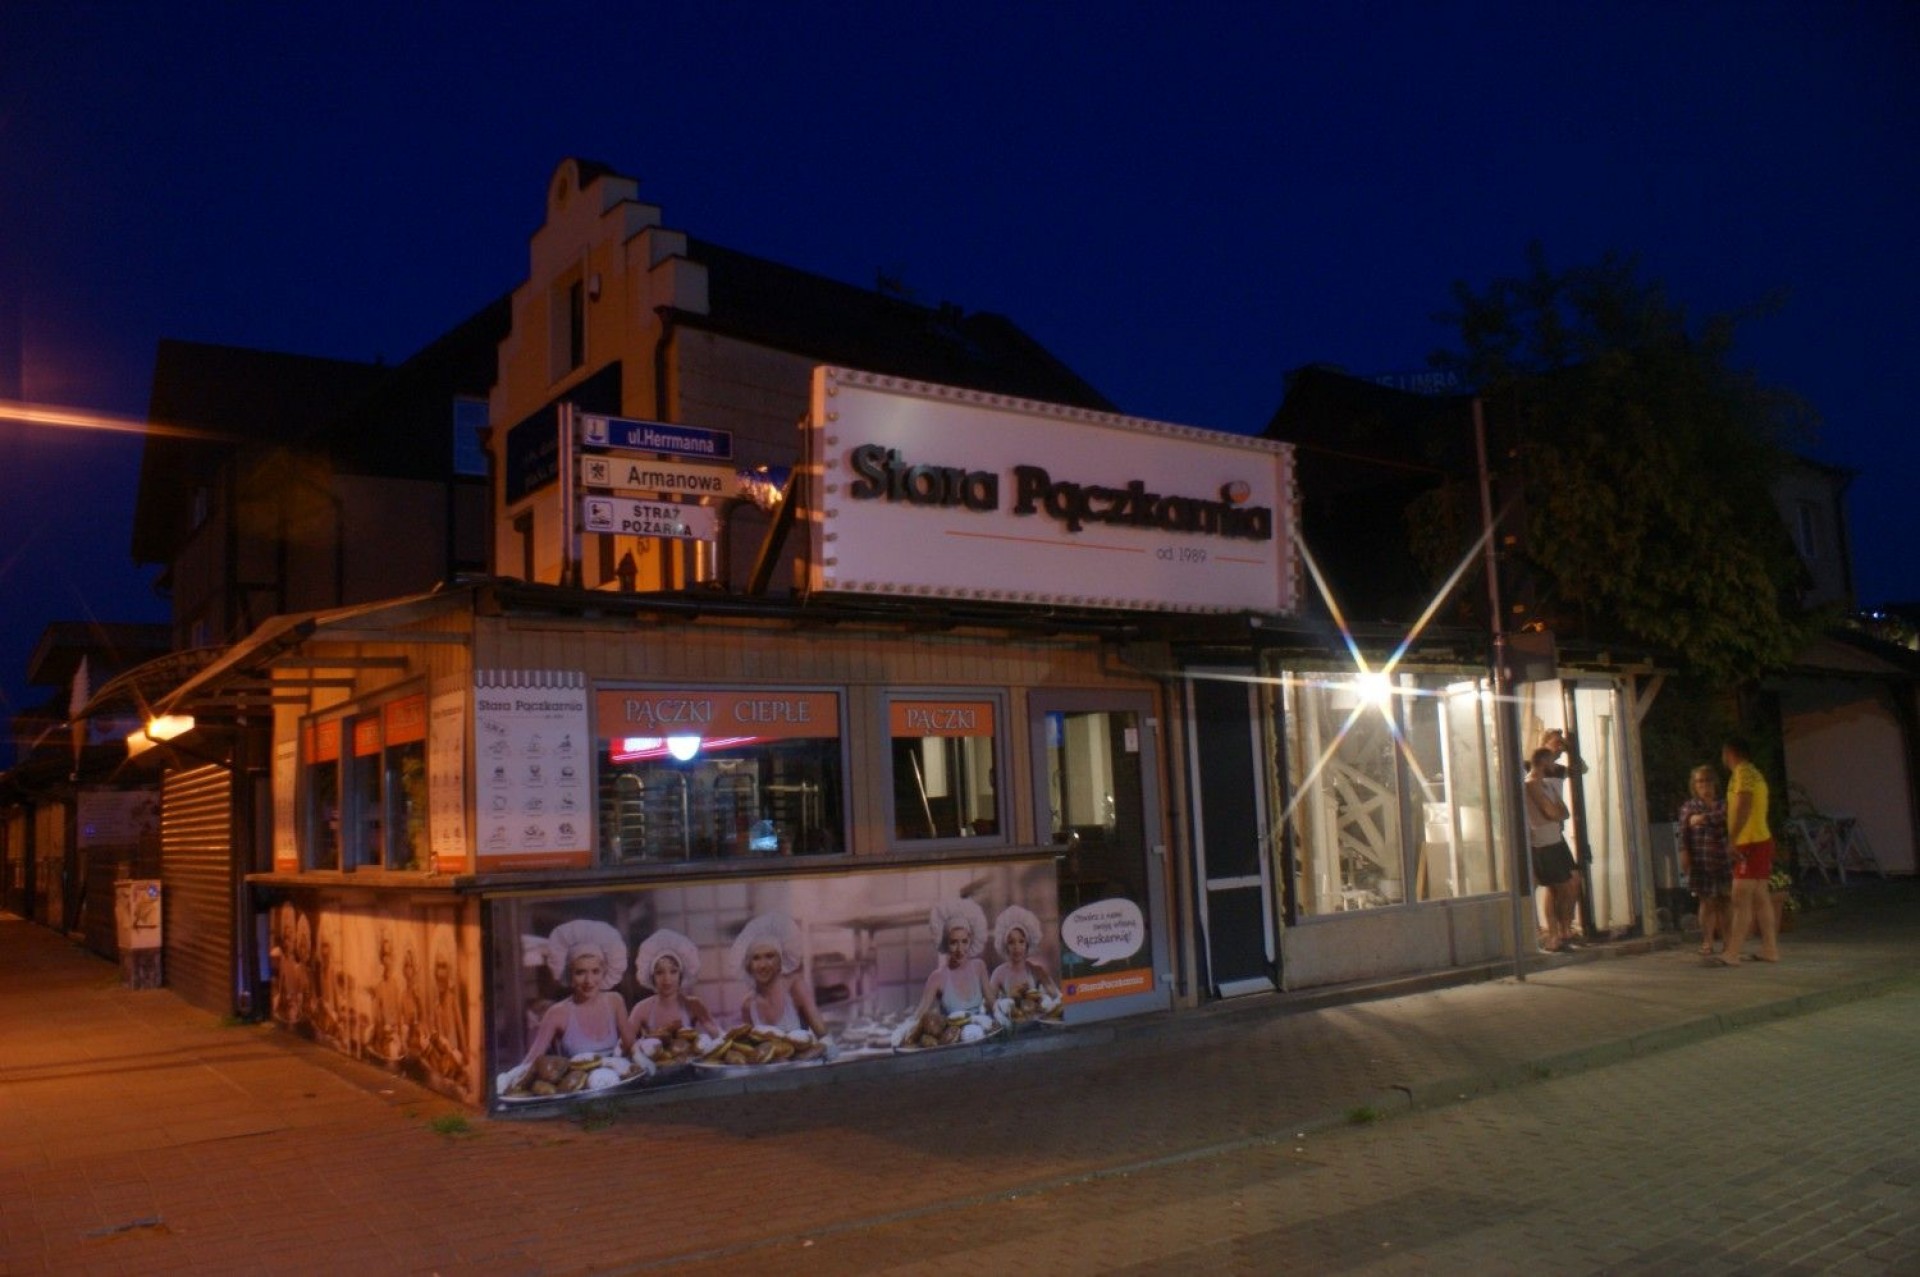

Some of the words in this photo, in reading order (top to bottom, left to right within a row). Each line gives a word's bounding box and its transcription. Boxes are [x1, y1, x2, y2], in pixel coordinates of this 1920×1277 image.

[627, 427, 715, 454] ul.Herrmanna
[627, 466, 723, 491] Armanowa
[851, 443, 998, 513] Stara
[1012, 465, 1273, 540] Pączkarnia
[622, 519, 693, 537] POŻARA
[1156, 546, 1174, 561] od
[1179, 547, 1207, 563] 1989
[478, 699, 512, 712] Stara
[624, 699, 712, 729] PĄCZKI
[733, 699, 811, 723] CIEPŁE
[906, 707, 976, 735] PĄCZKI
